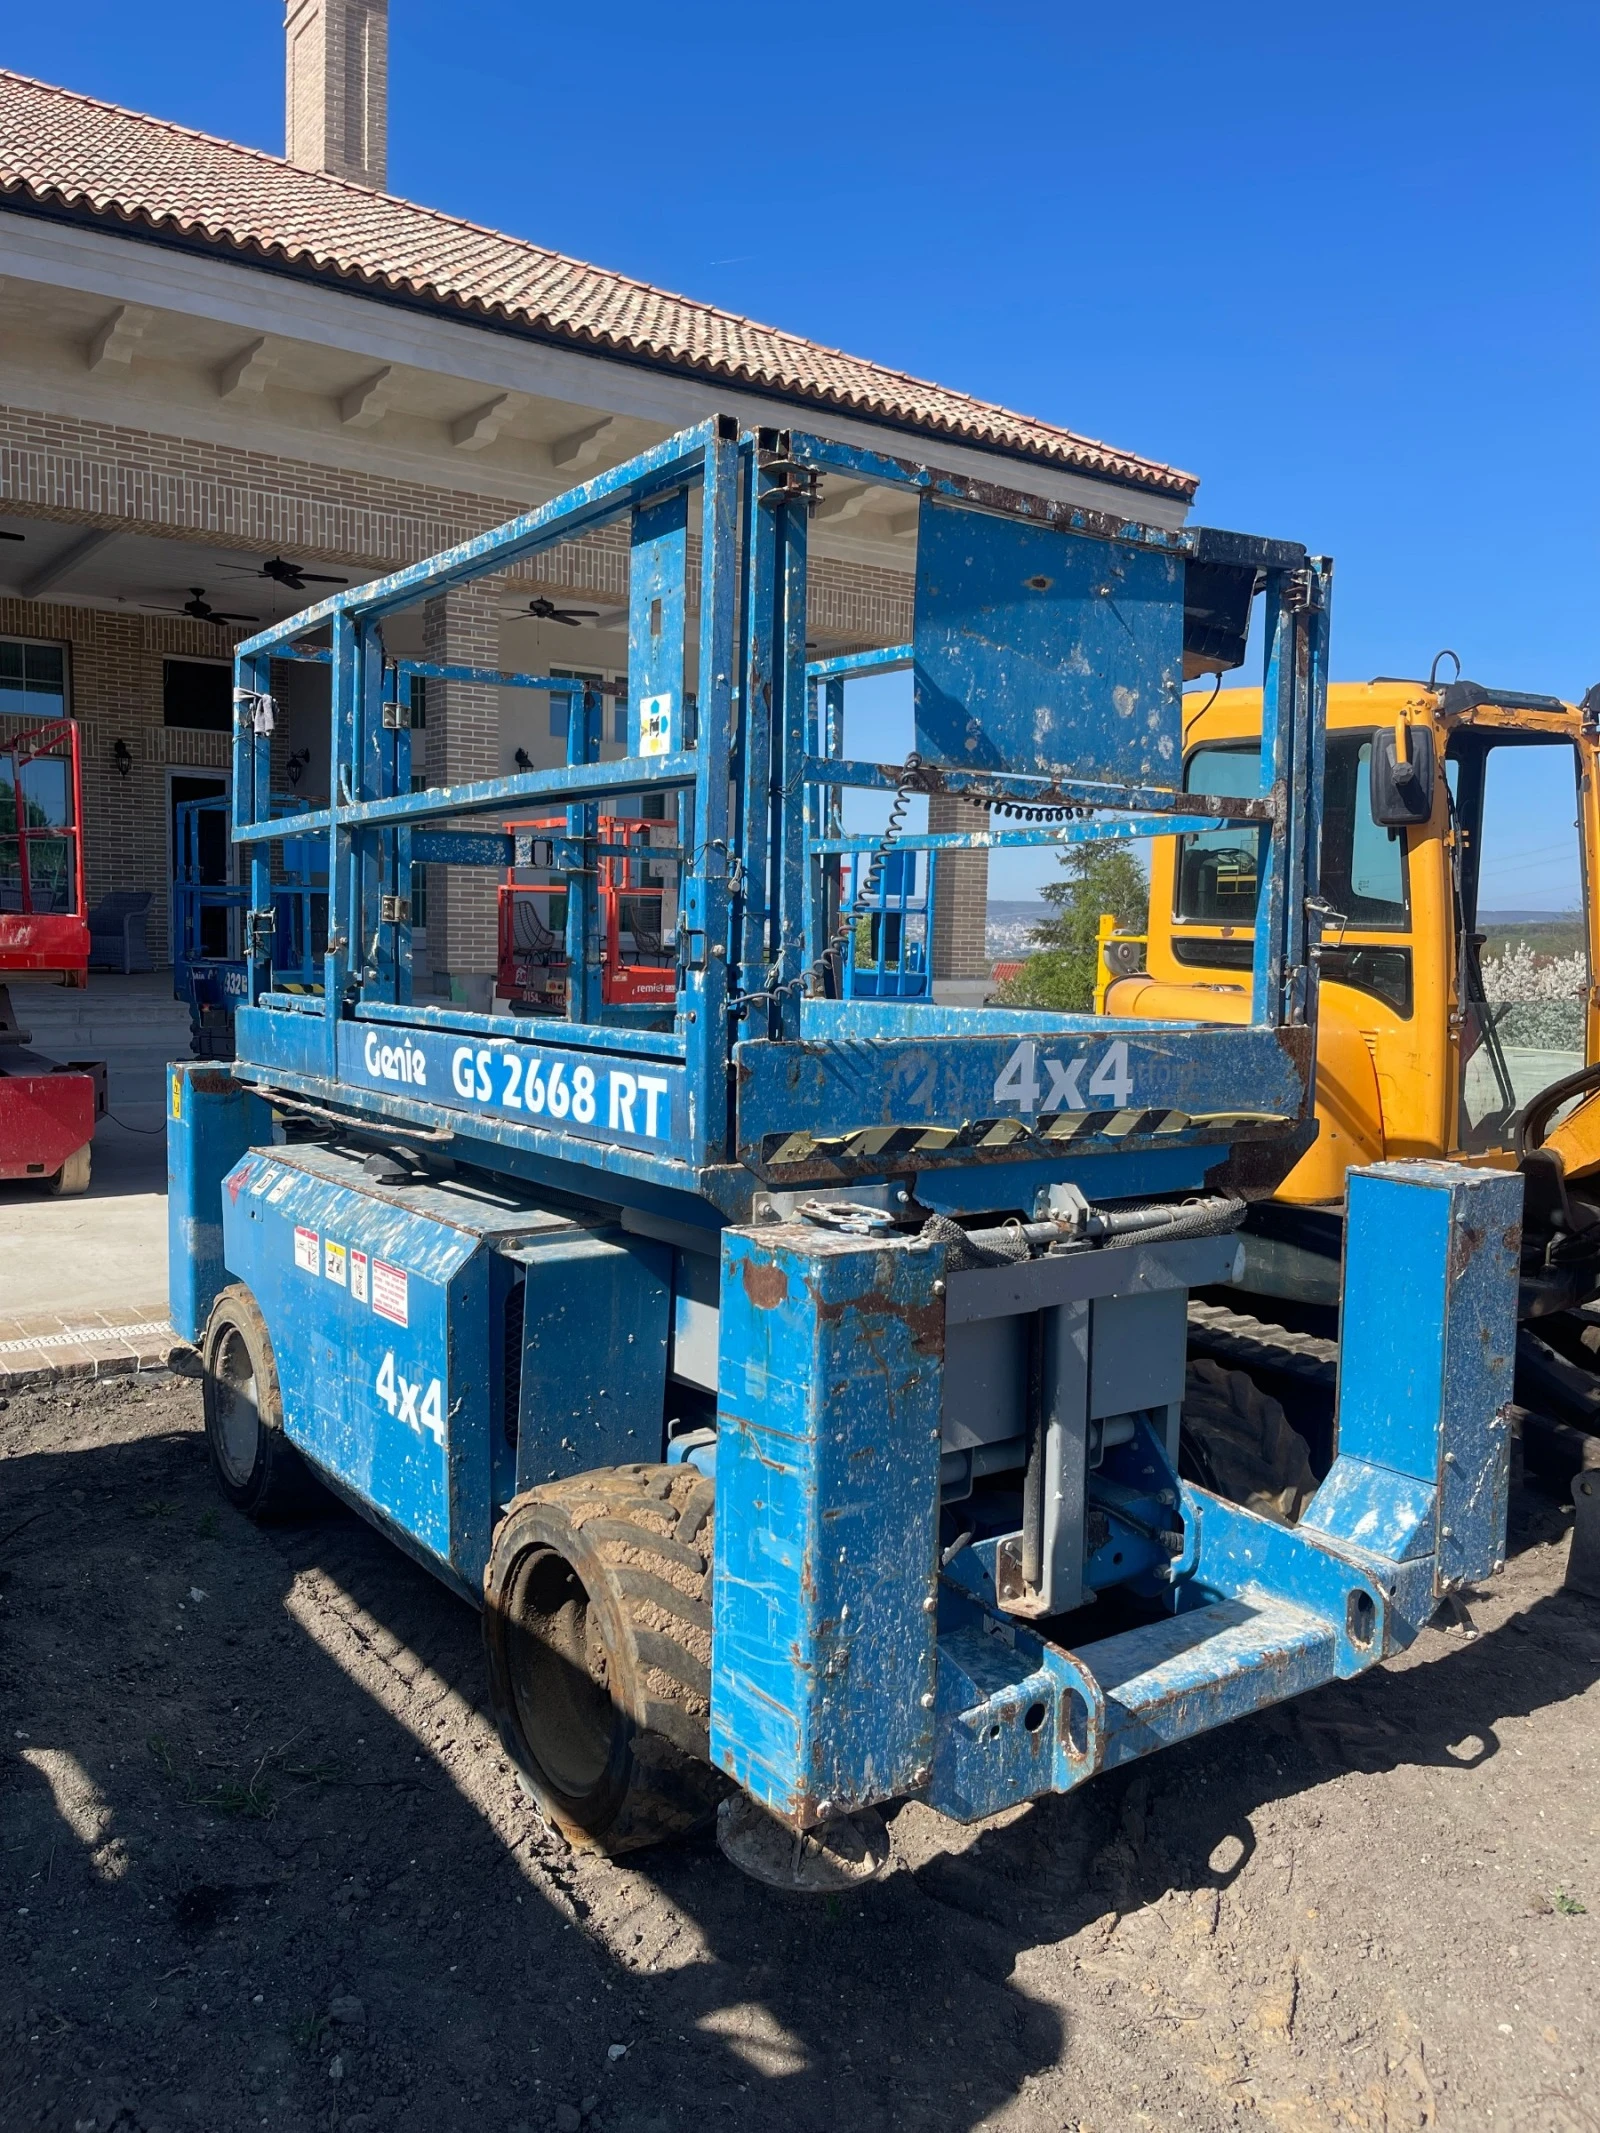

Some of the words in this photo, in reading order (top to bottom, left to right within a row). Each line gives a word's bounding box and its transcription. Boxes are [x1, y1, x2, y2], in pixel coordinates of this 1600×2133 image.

[632, 983, 664, 995] remier
[365, 1031, 427, 1086] Genie
[452, 1047, 493, 1102] GS
[502, 1054, 596, 1123] 2668
[608, 1070, 668, 1137] RT
[993, 1040, 1133, 1113] 4x4
[376, 1351, 445, 1448] 4x4
